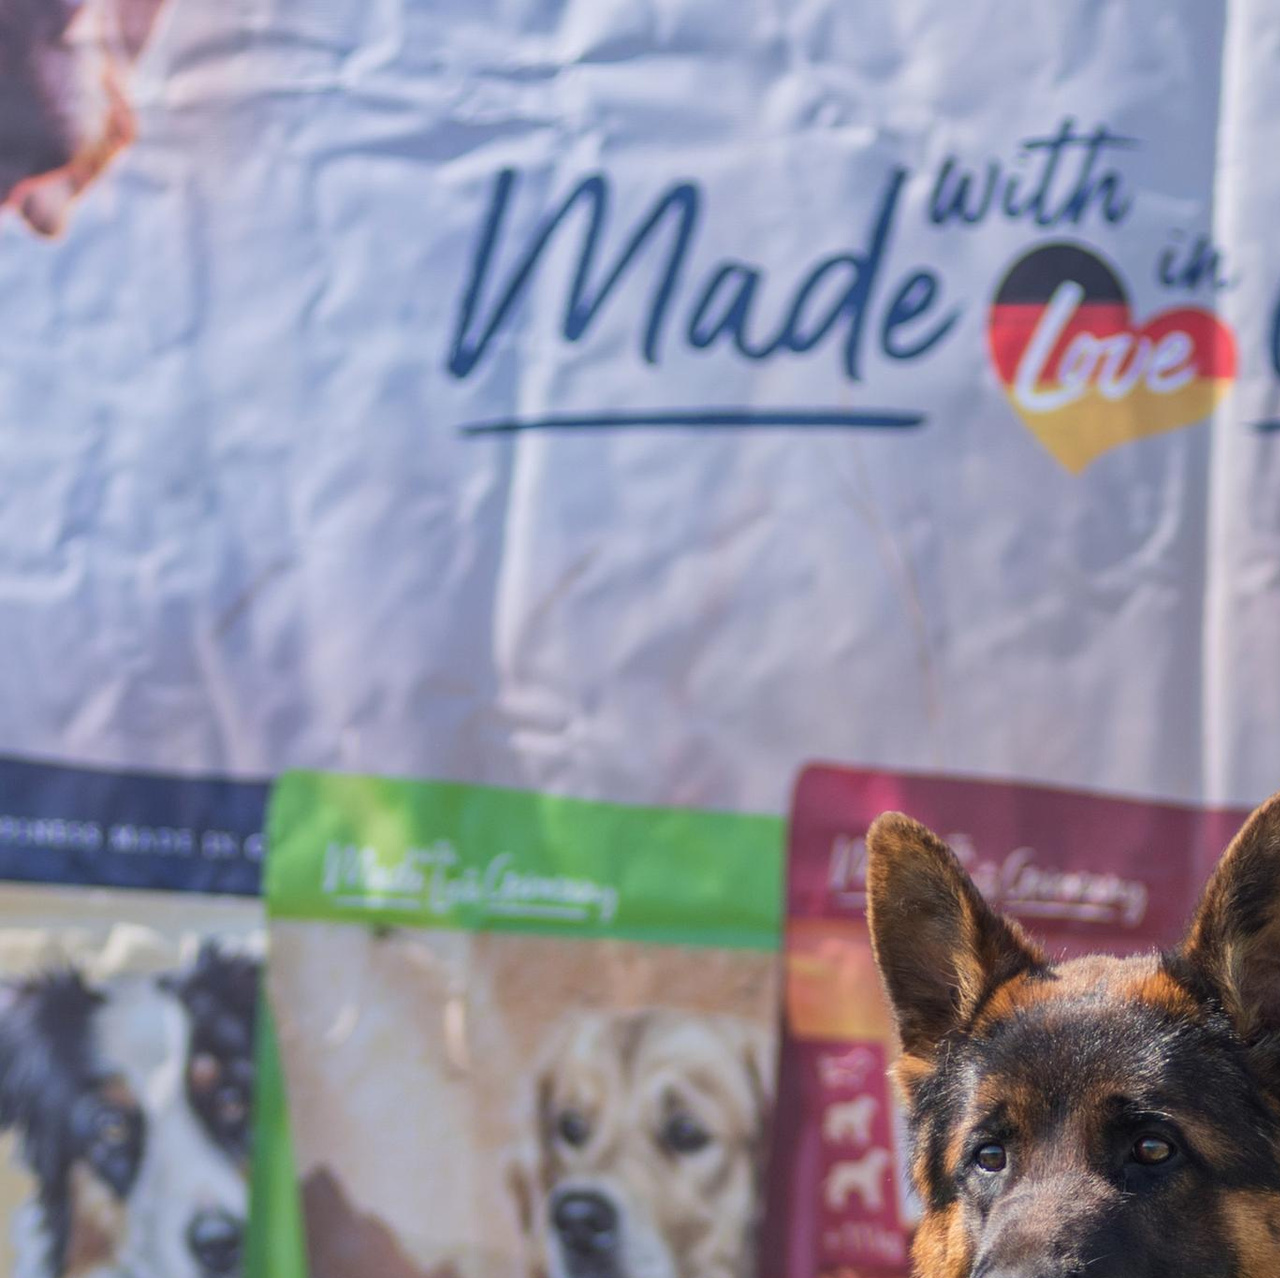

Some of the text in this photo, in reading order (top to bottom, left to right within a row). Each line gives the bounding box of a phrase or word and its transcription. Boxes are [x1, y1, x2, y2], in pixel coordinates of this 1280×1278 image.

[927, 119, 1139, 229] with
[446, 167, 962, 382] Made
[1013, 280, 1203, 411] Love
[1156, 231, 1240, 292] in
